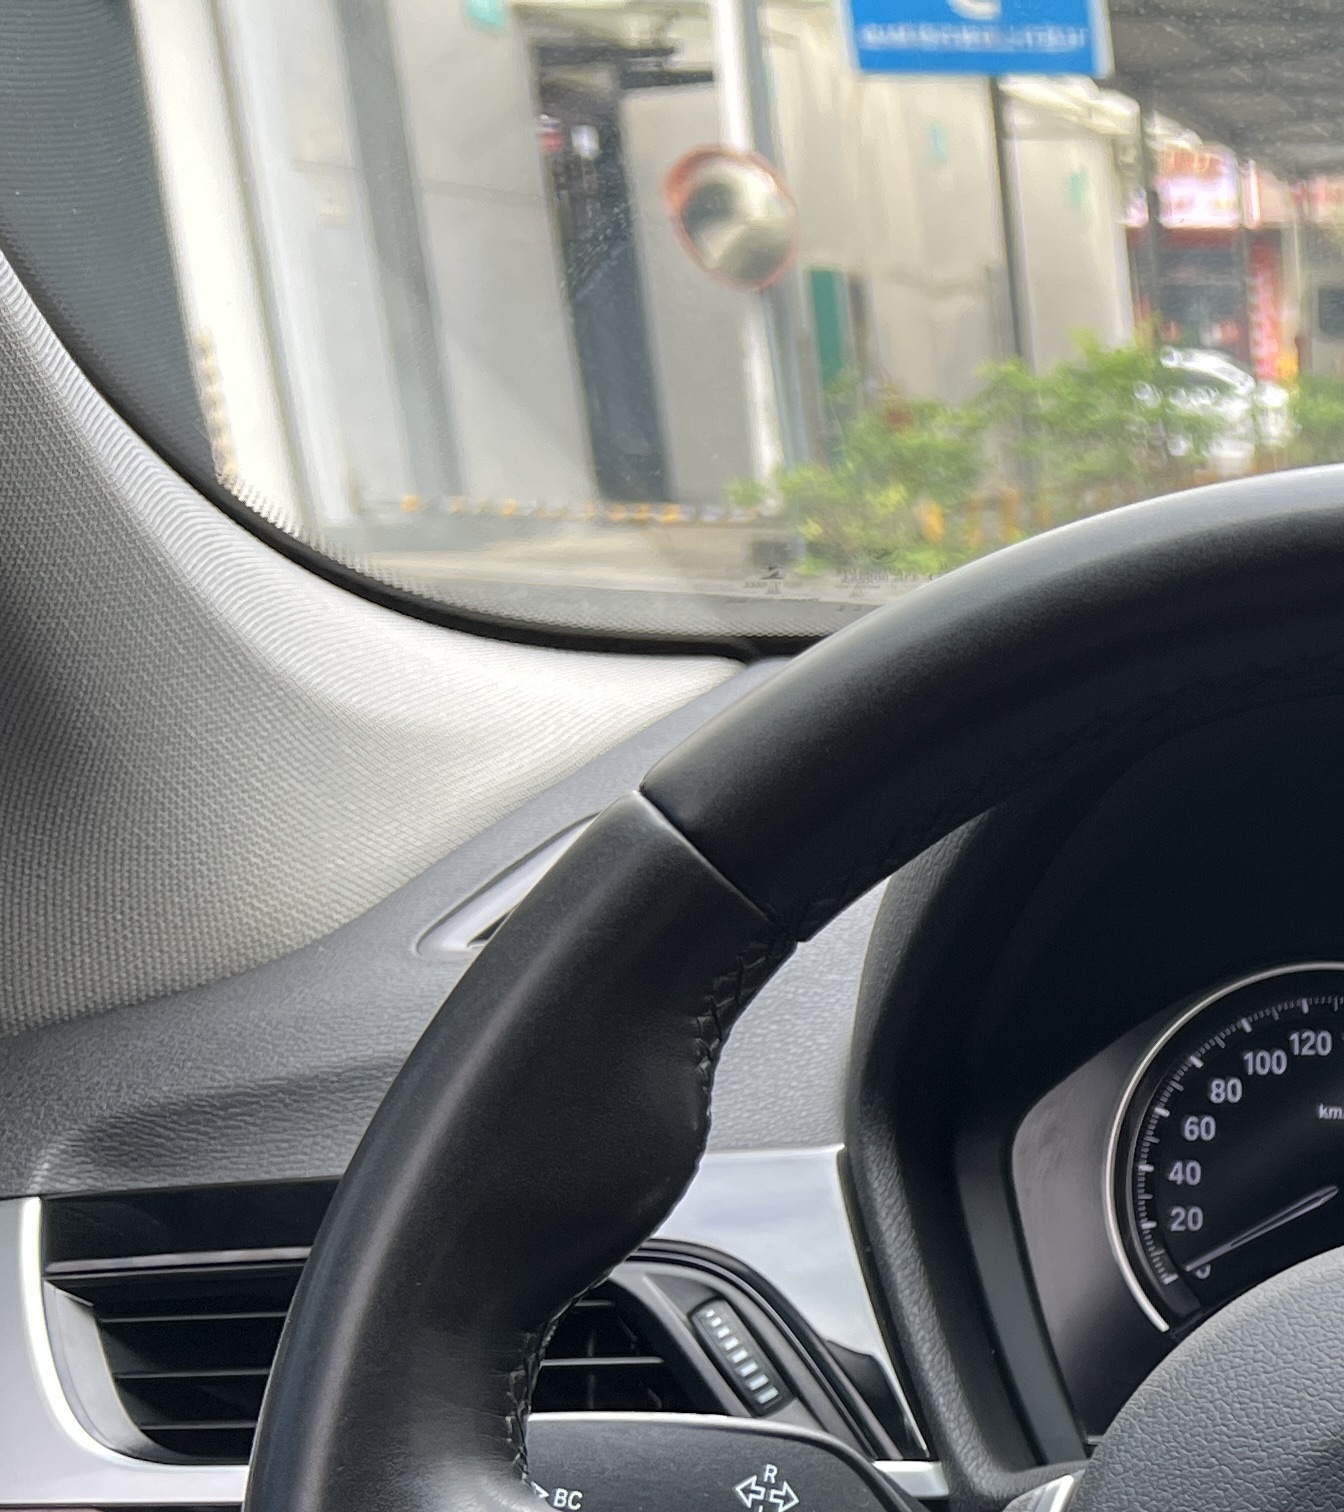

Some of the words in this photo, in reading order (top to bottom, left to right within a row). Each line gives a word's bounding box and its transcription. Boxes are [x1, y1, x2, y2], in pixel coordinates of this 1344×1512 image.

[1289, 1030, 1333, 1056] 120
[1243, 1049, 1288, 1076] 100
[1209, 1077, 1243, 1104] 80
[1183, 1115, 1216, 1142] 60
[1168, 1160, 1202, 1187] 40
[1170, 1206, 1204, 1232] 20
[763, 1463, 779, 1484] R
[553, 1487, 583, 1511] BC
